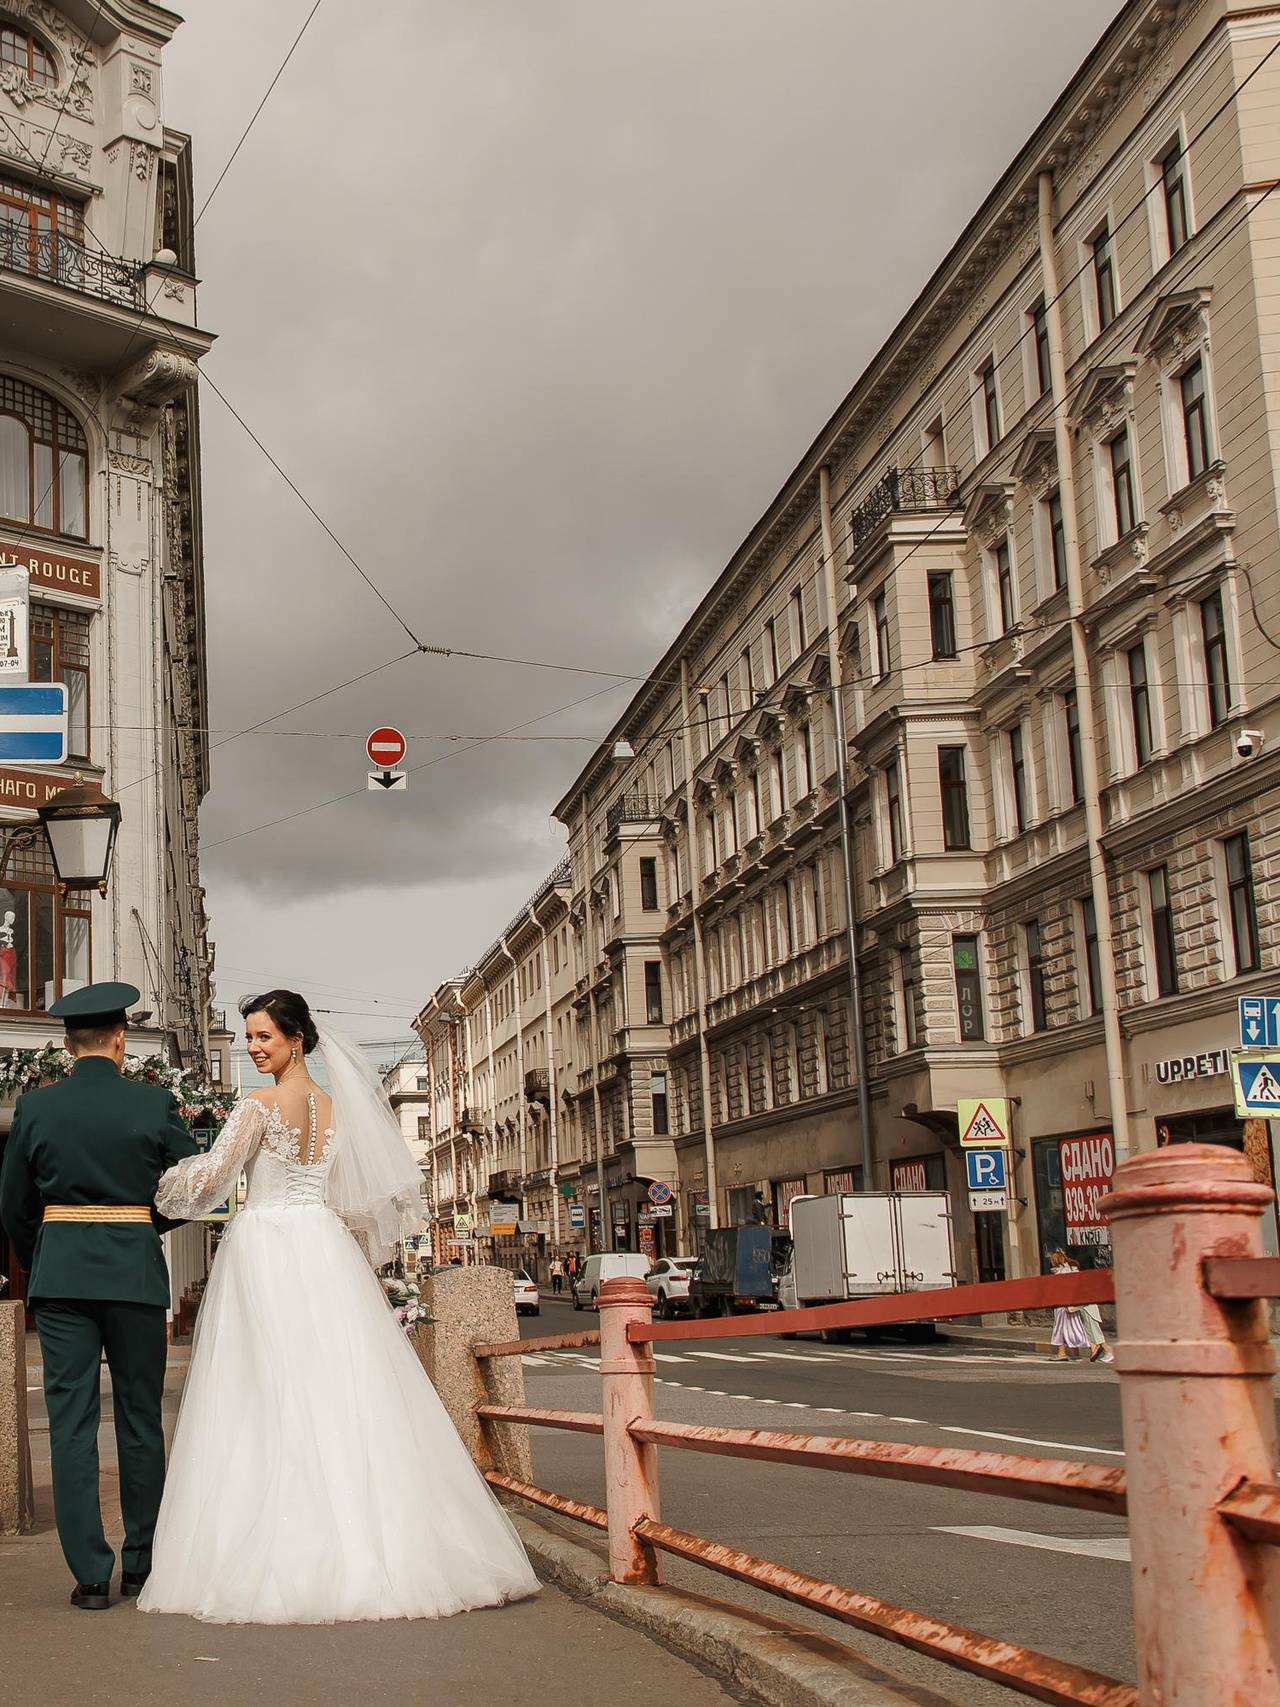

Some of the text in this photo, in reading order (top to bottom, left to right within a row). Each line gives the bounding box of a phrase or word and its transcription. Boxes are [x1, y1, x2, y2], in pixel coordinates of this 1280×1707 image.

[29, 558, 93, 587] ROUGE
[1155, 1048, 1230, 1085] UPPETI
[975, 1154, 996, 1183] P
[1061, 1138, 1113, 1182] СДАНО
